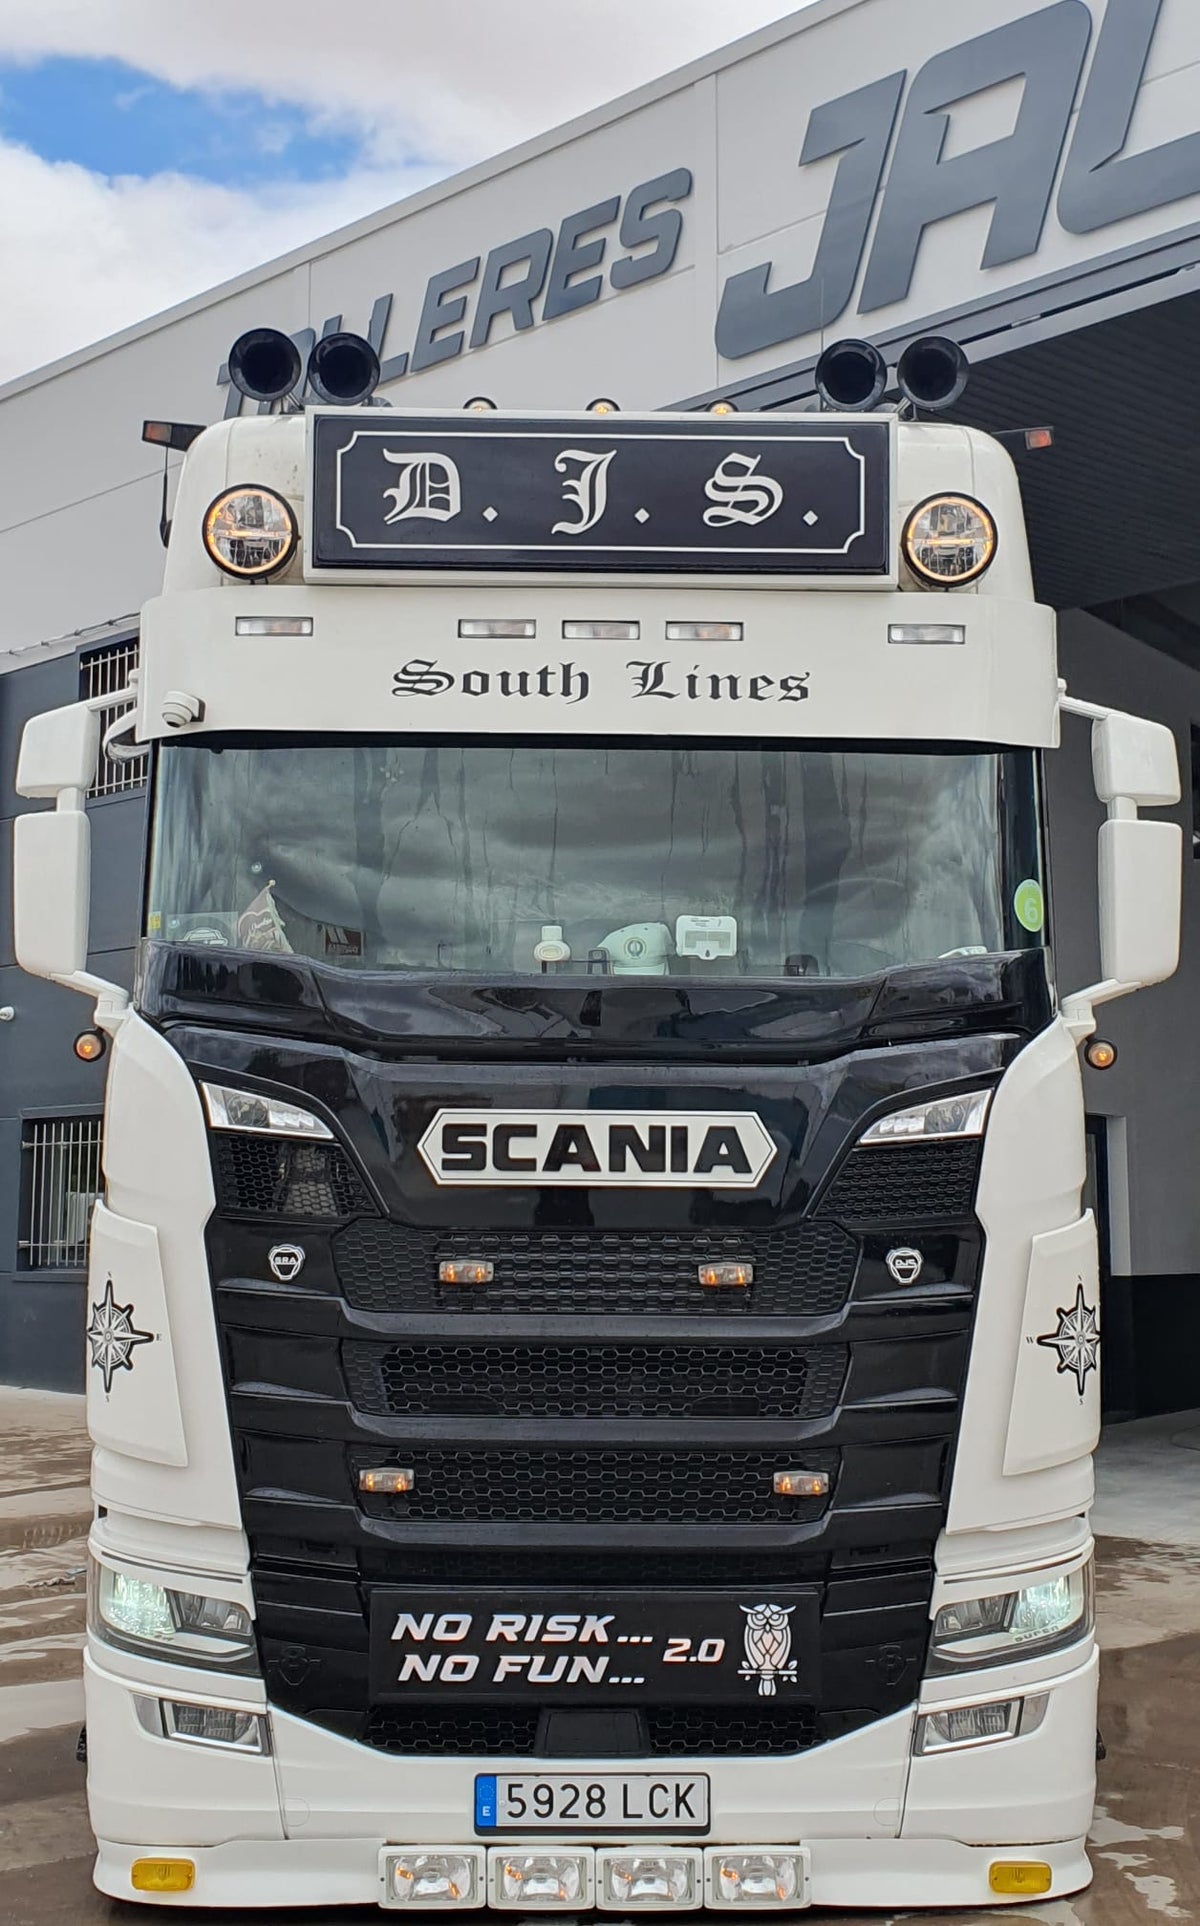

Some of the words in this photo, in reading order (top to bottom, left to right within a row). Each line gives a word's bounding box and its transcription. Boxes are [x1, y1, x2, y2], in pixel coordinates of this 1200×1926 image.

[391, 658, 591, 704] South
[625, 660, 811, 702] Lines
[1024, 898, 1038, 923] 6
[442, 1124, 752, 1173] SCANIA
[391, 1613, 473, 1642] NO
[486, 1613, 654, 1643] RISK...
[662, 1638, 727, 1663] 2.0
[398, 1654, 480, 1683] NO
[492, 1655, 646, 1684] FUN...
[482, 1805, 491, 1817] E
[506, 1783, 607, 1819] 5928
[622, 1783, 697, 1819] LCK
